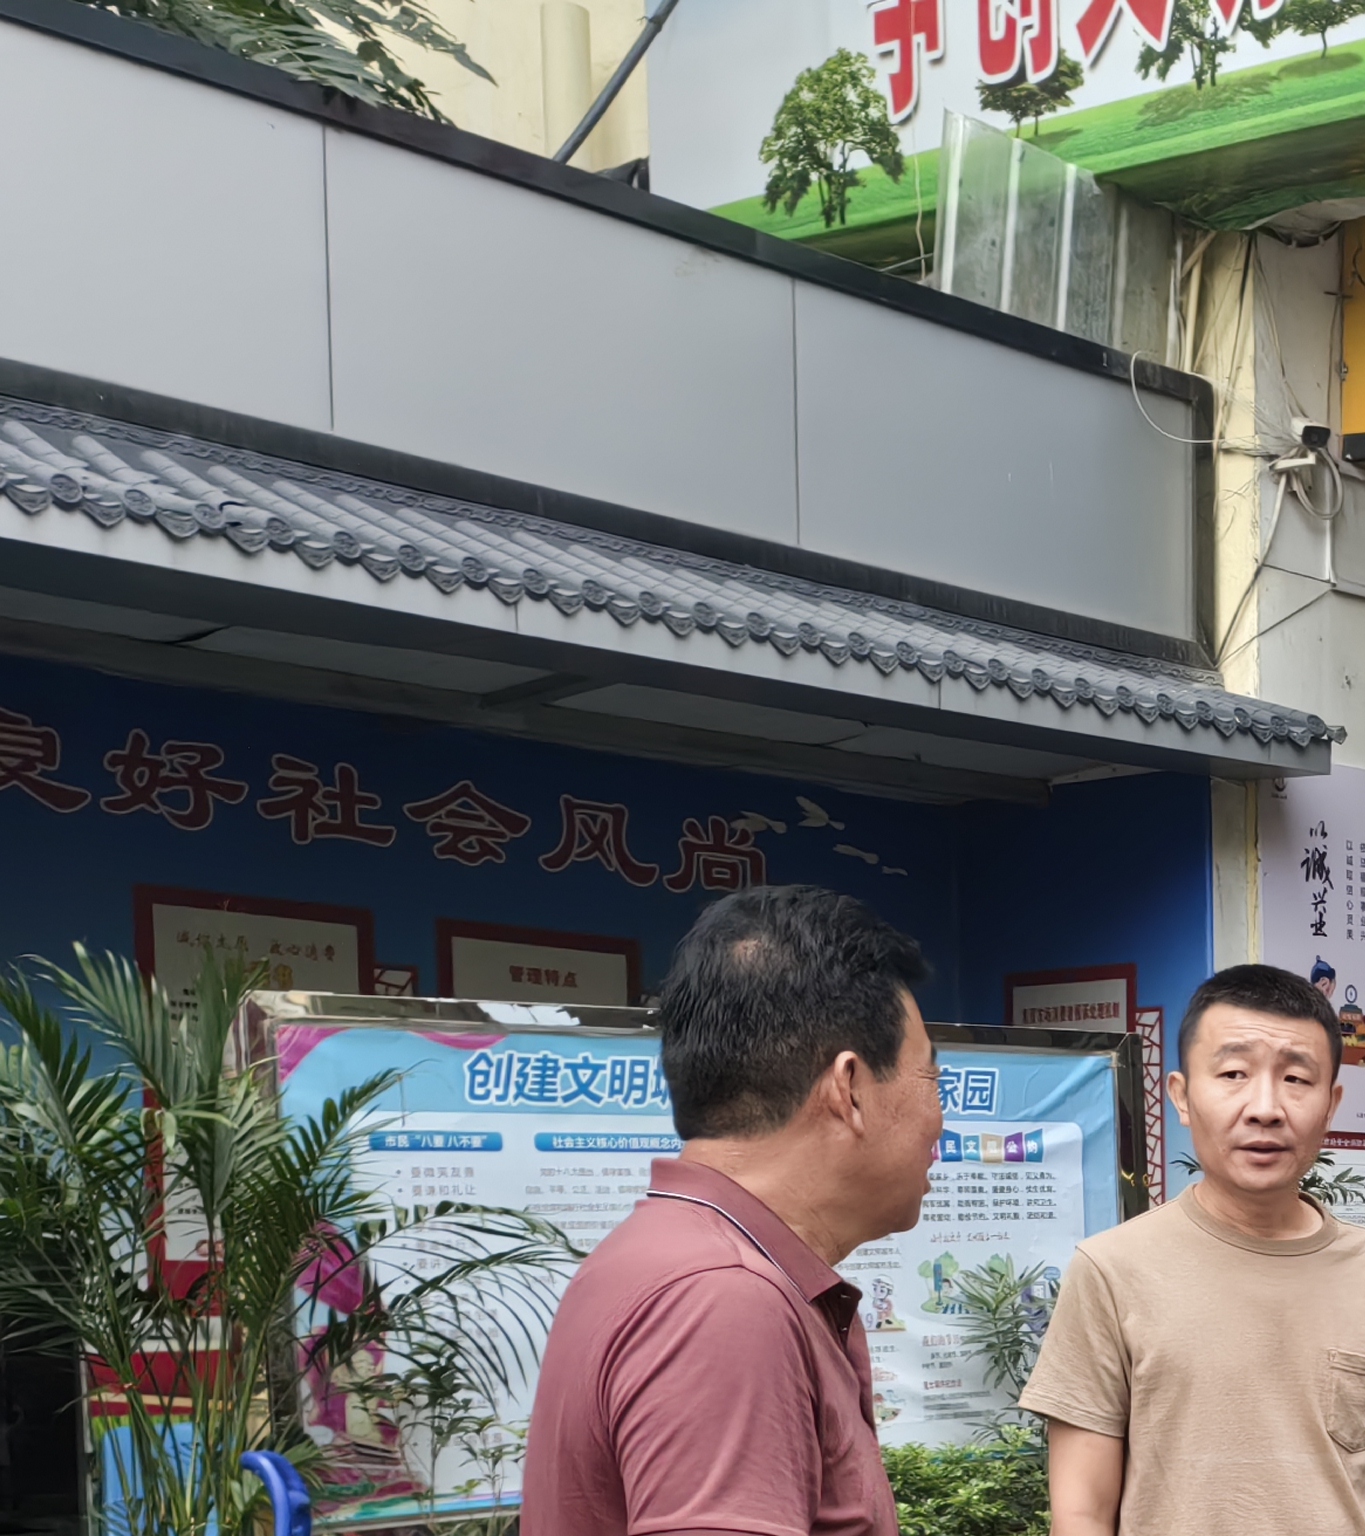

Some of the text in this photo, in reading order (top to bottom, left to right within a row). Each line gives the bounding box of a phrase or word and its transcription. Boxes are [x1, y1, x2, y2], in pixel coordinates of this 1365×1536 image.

[0, 706, 768, 893] 良好社会风尚
[509, 965, 579, 988] 管理特点
